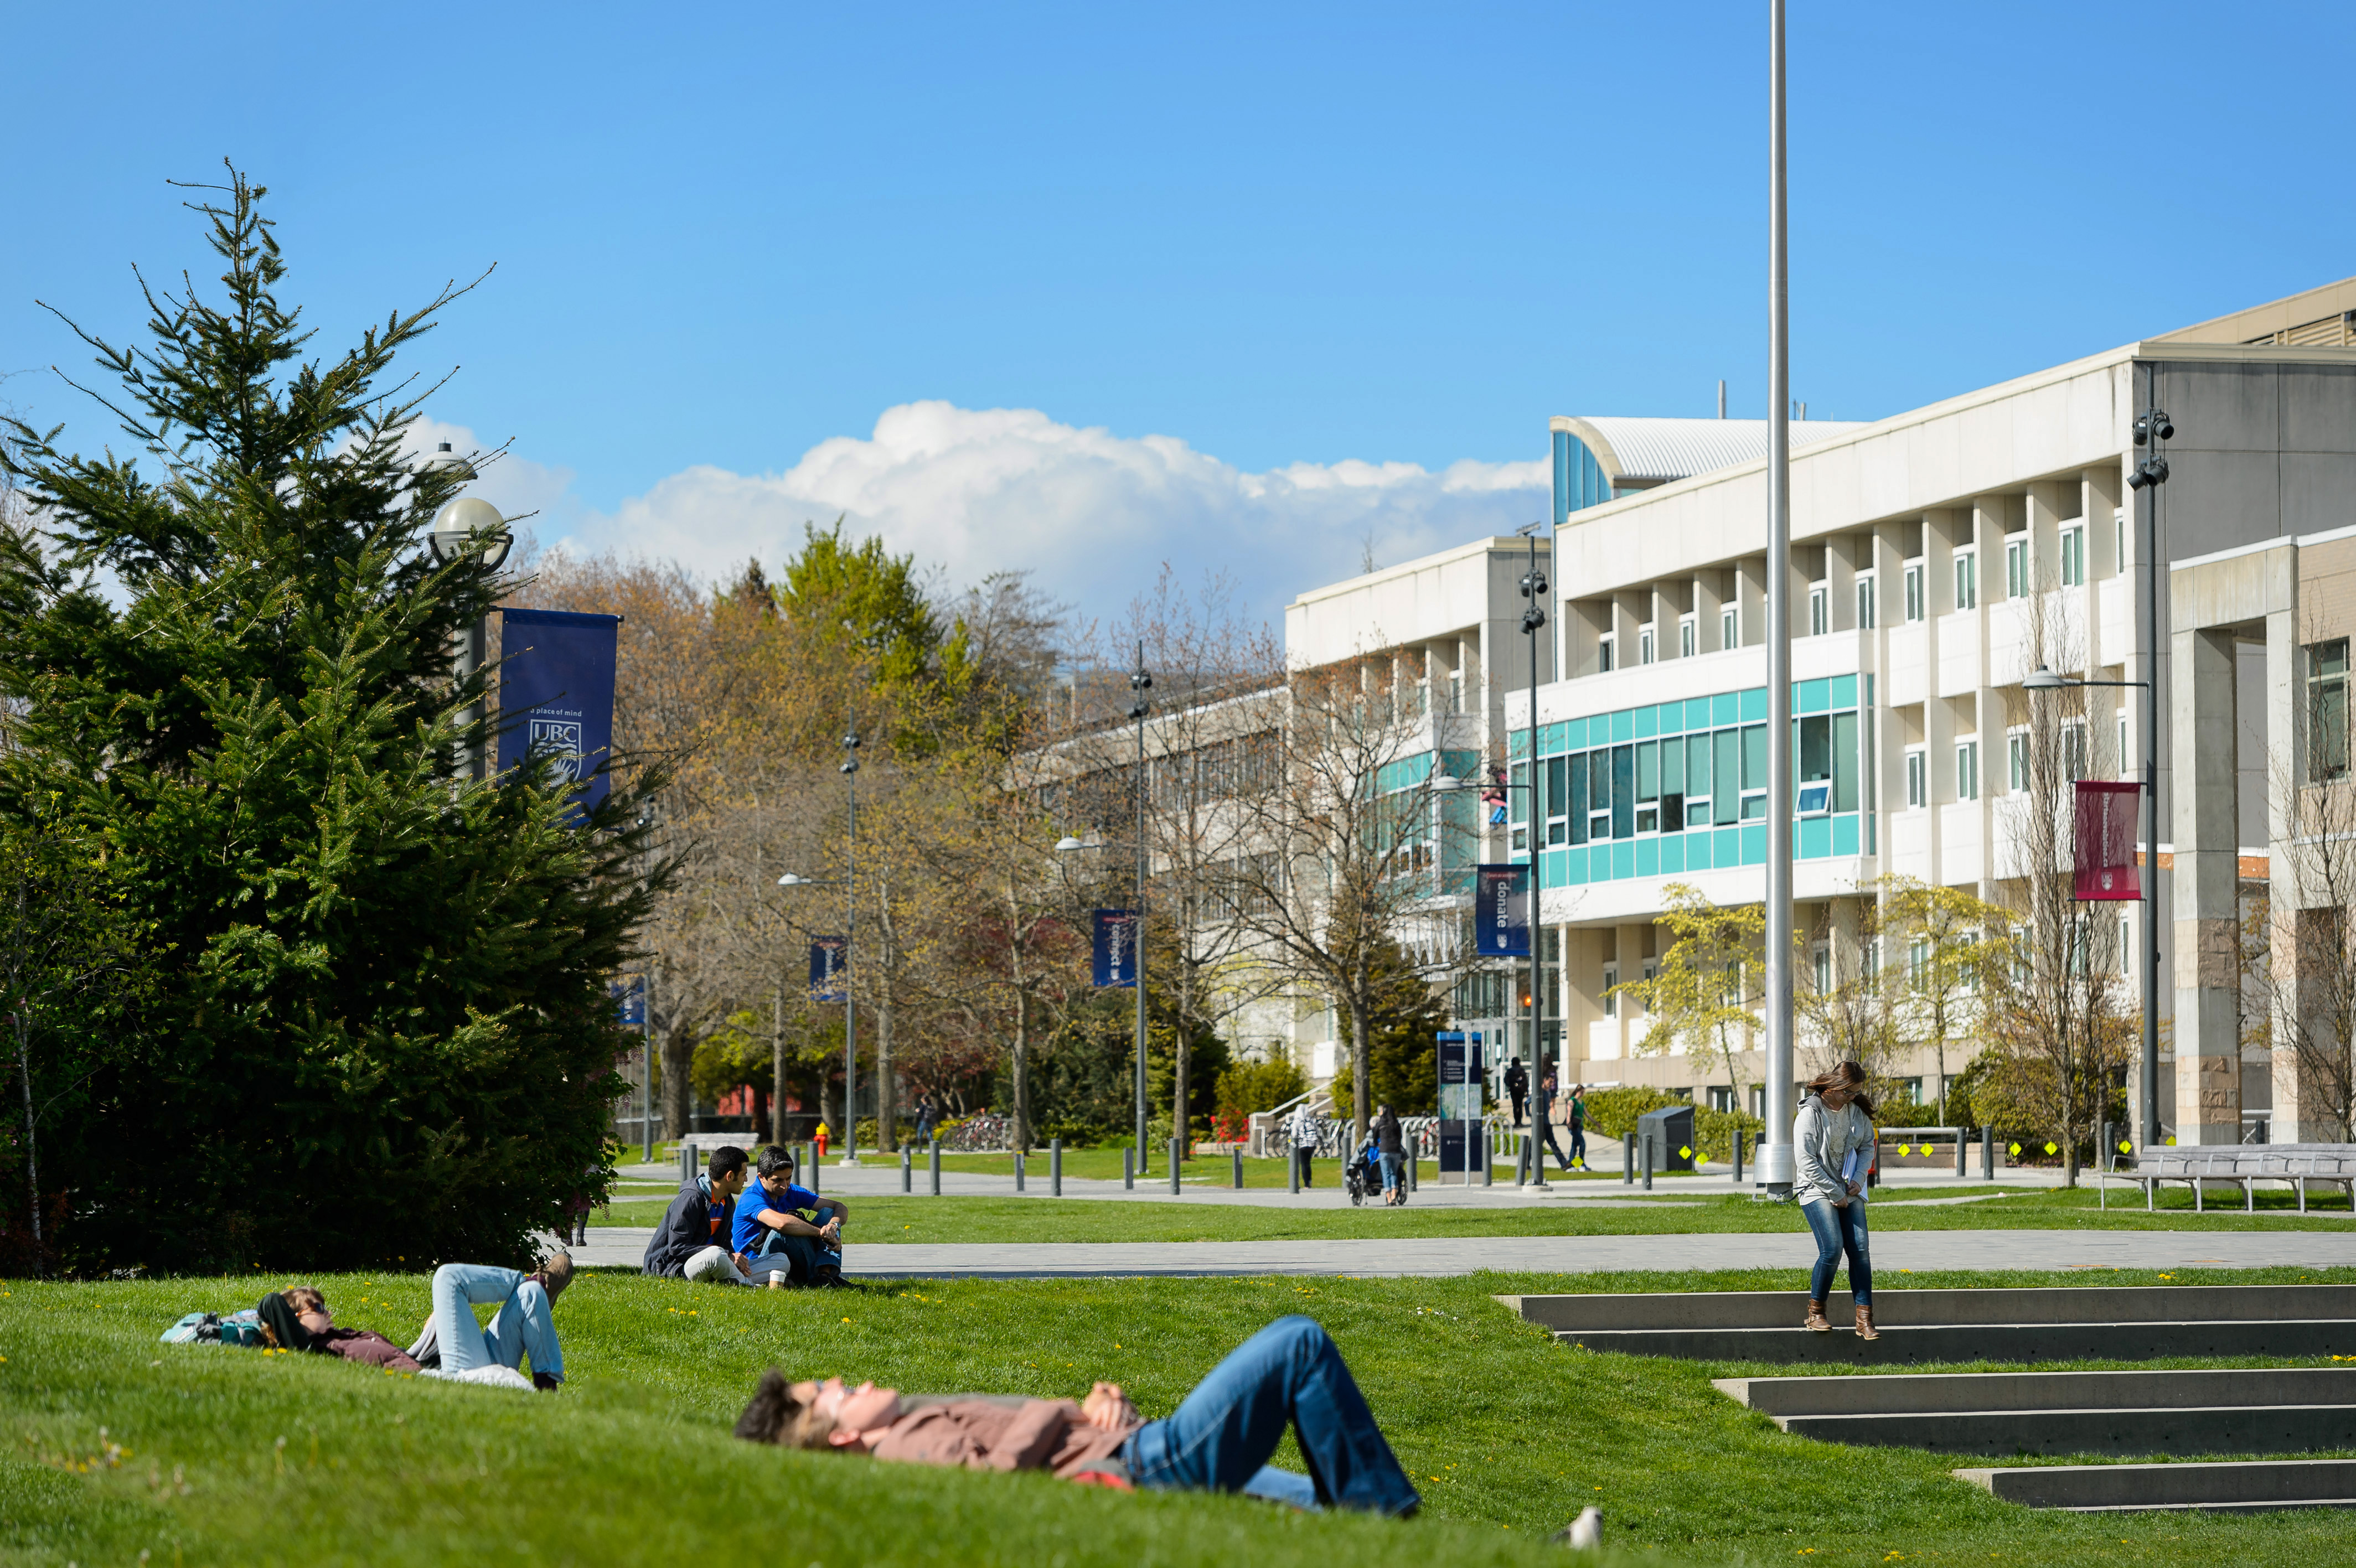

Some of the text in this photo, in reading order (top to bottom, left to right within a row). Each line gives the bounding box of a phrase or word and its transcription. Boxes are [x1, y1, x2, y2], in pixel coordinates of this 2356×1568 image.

[535, 724, 576, 742] UBC
[1497, 881, 1509, 928] donate
[1110, 924, 1121, 966] connect
